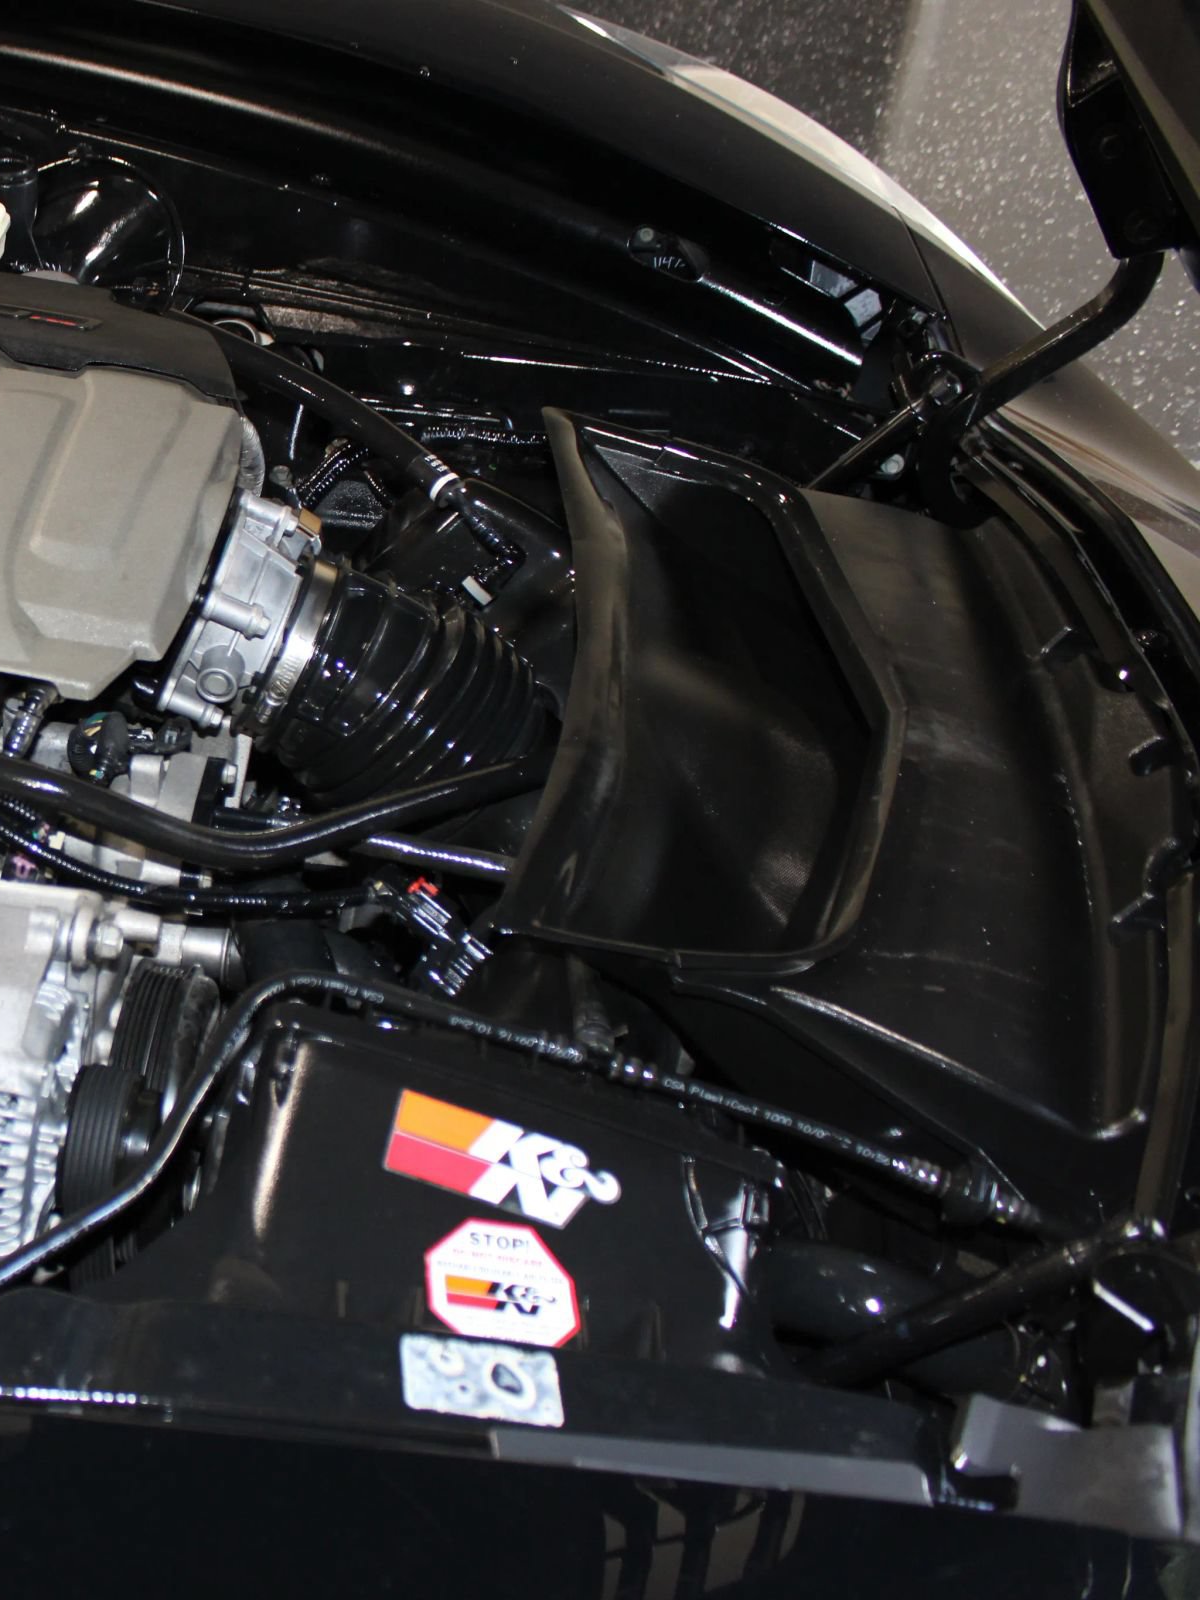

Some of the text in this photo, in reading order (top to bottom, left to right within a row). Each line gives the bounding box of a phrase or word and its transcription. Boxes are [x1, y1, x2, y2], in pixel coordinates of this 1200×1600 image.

[662, 1077, 687, 1093] CSA
[467, 1118, 622, 1230] K&N
[470, 1231, 531, 1251] STOP!
[487, 1281, 557, 1316] K&N
